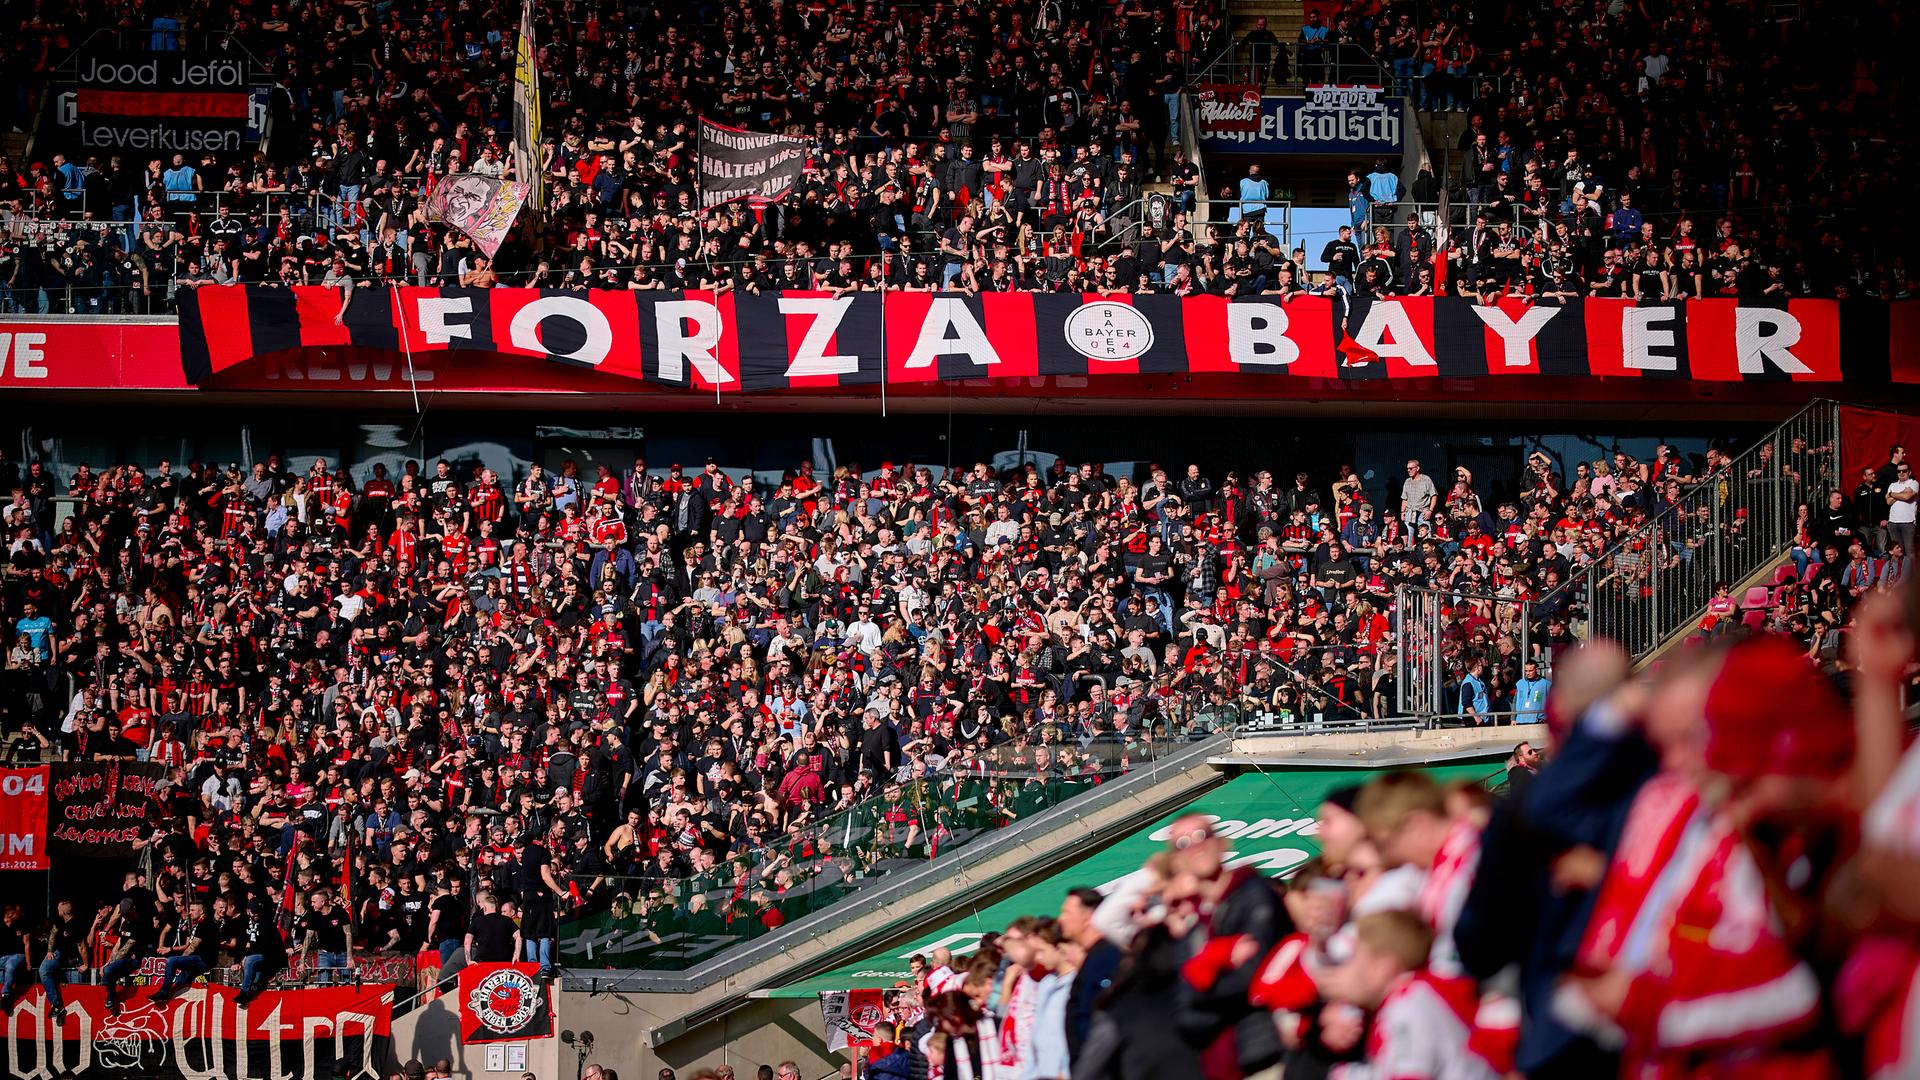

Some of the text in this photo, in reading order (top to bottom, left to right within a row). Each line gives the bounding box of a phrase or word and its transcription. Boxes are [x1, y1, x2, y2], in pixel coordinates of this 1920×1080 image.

[81, 57, 243, 85] Jood Jeföl
[1313, 91, 1377, 105] OPLADEN
[1201, 100, 1260, 124] Addicts
[81, 120, 241, 151] Leverkusen
[702, 148, 801, 178] HALTEN UNS
[760, 175, 793, 197] AUF
[417, 295, 1815, 383] FORZA BAYER
[1085, 328, 1137, 337] BAYER
[1103, 309, 1116, 355] BAYER
[2, 774, 45, 796] 04
[480, 974, 533, 1001] HABERLANDS
[511, 1005, 530, 1025] 2003
